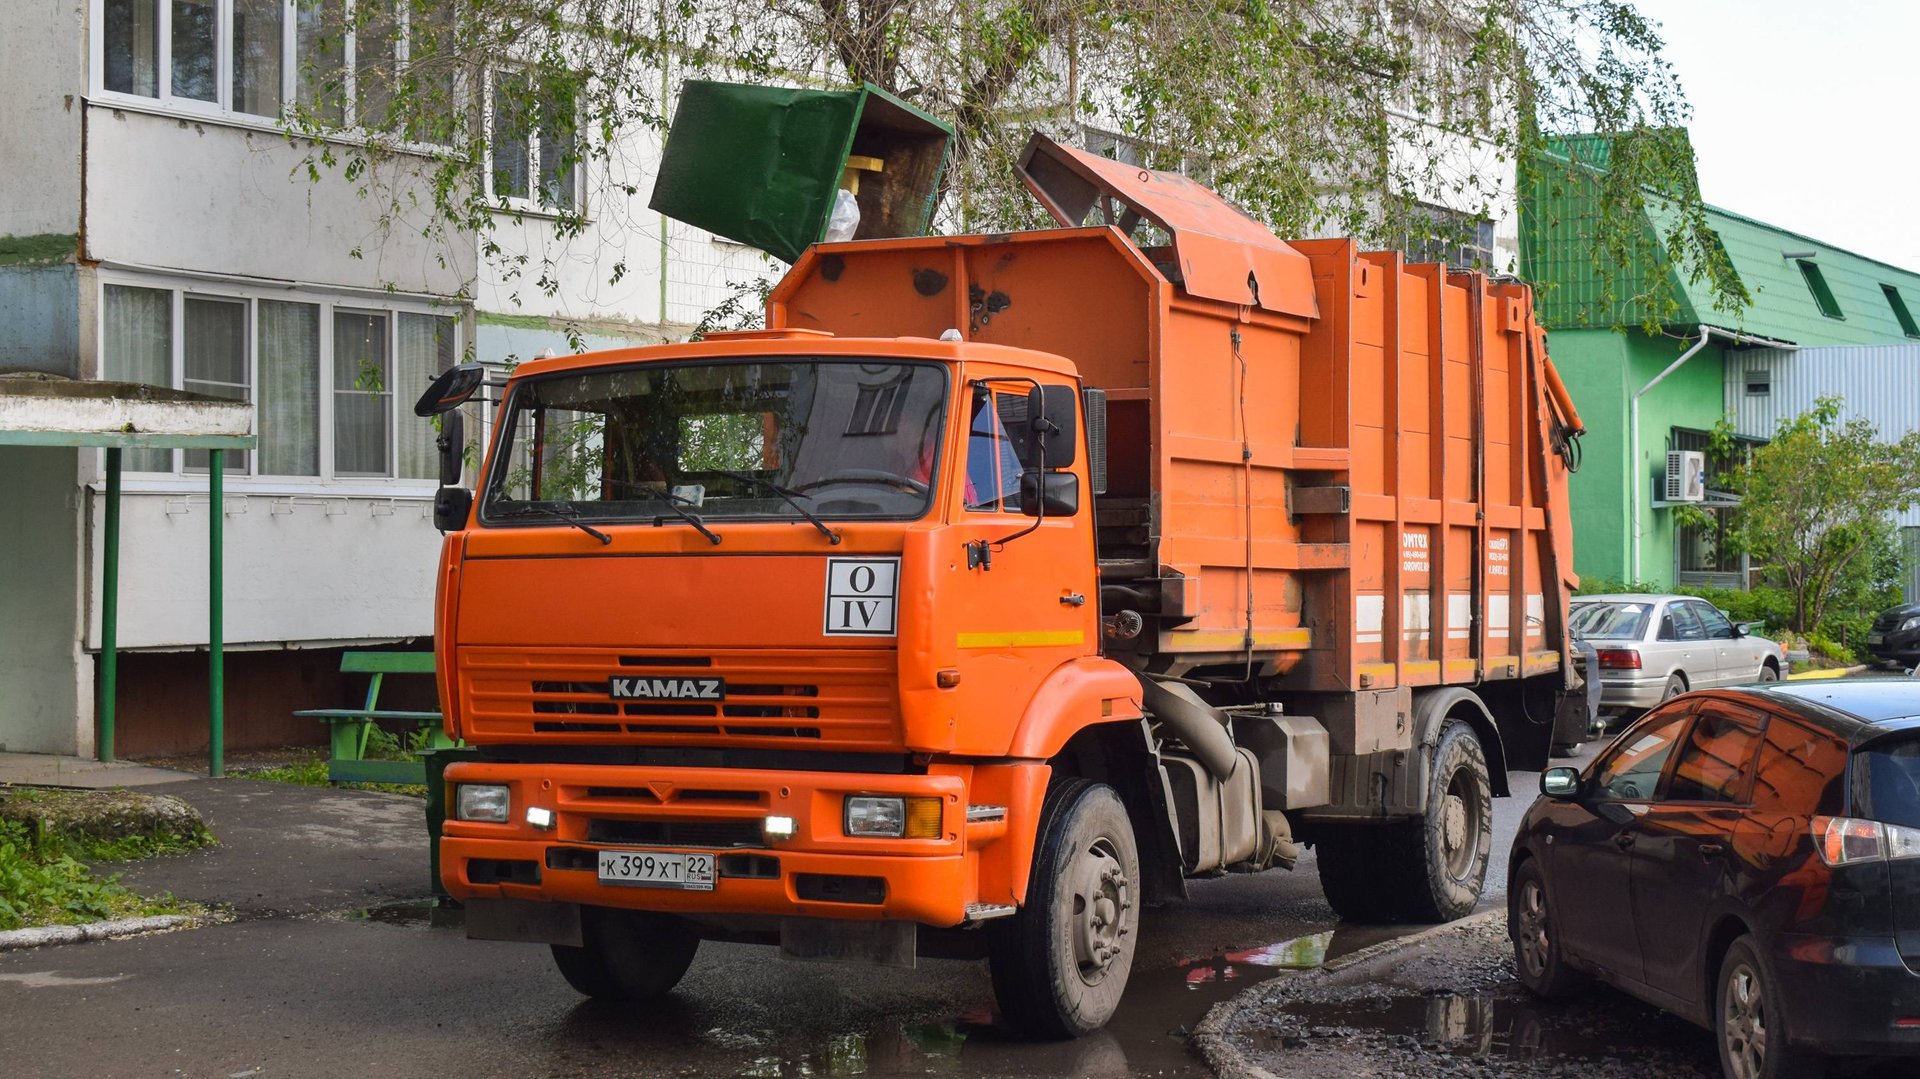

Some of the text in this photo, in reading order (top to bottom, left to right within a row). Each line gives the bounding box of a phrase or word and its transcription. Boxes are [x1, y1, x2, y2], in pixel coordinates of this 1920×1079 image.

[849, 565, 876, 593] O
[840, 600, 881, 628] IV
[612, 679, 720, 698] KAMAZ
[687, 856, 707, 874] 22
[686, 873, 701, 881] RUS
